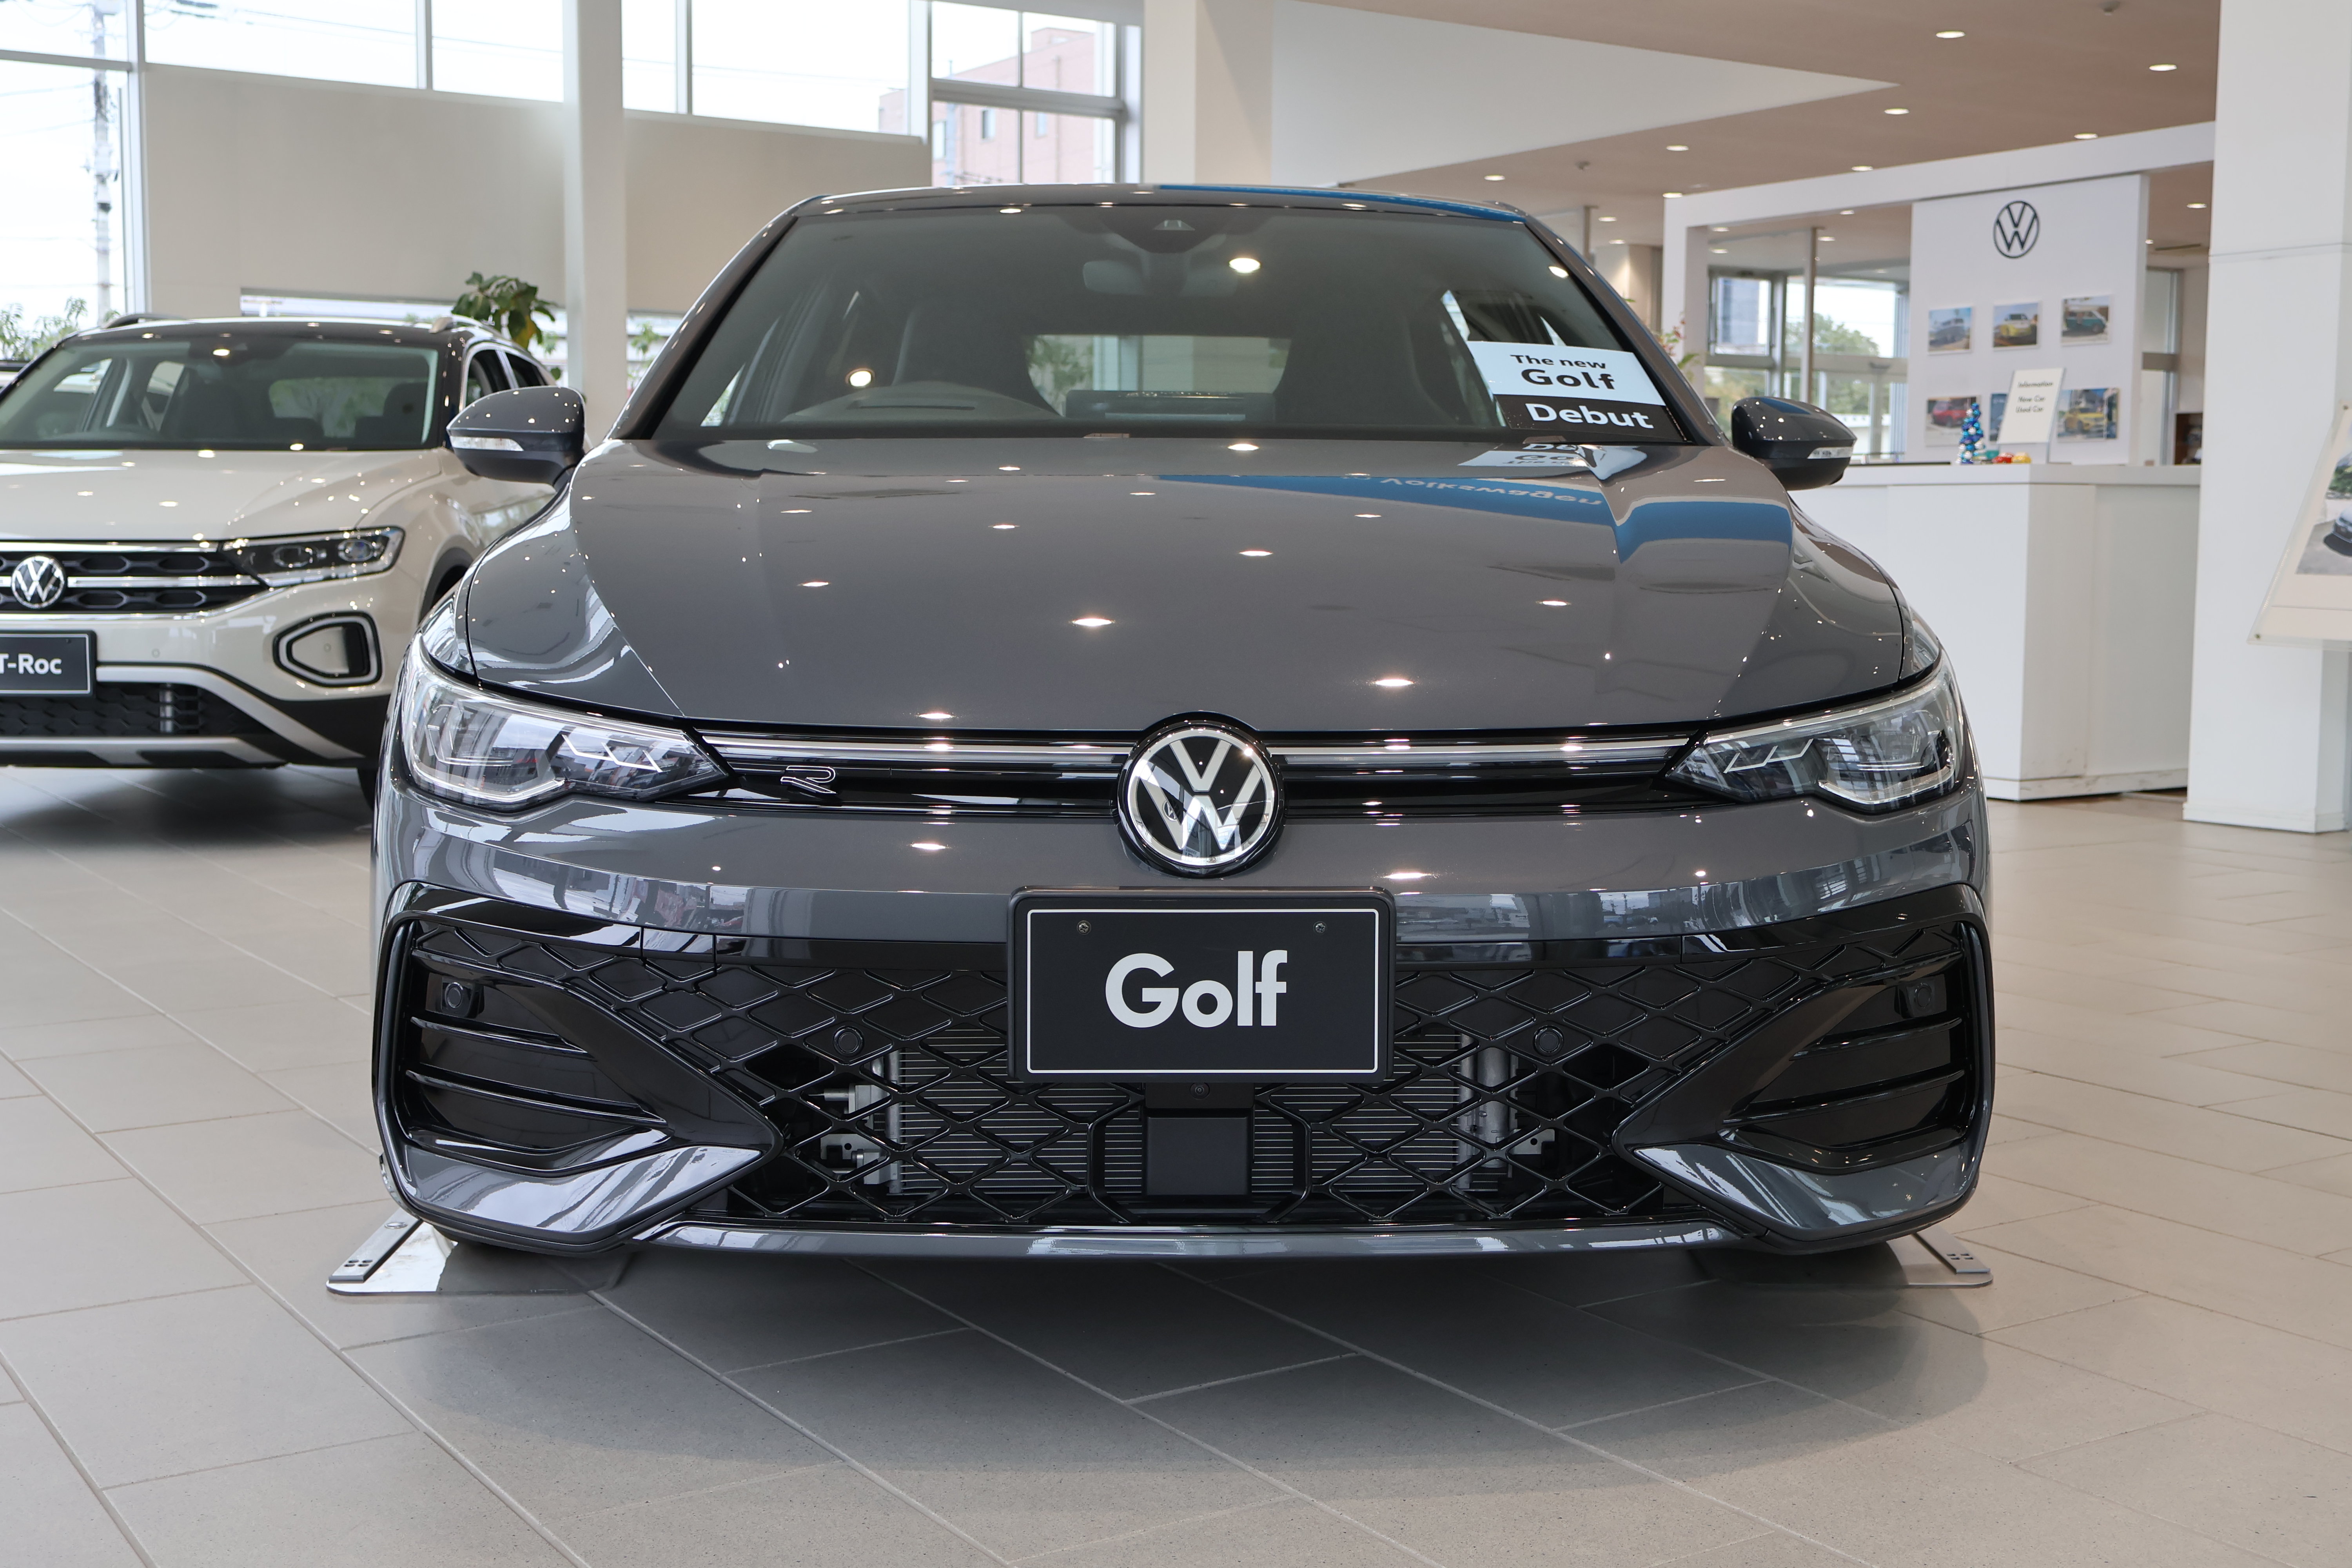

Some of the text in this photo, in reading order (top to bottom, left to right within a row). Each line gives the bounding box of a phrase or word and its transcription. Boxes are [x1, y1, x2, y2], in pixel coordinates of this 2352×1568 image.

[1510, 355, 1606, 369] The new
[1521, 369, 1615, 390] Golf
[1525, 403, 1654, 428] Debut
[1105, 950, 1287, 1028] Golf
